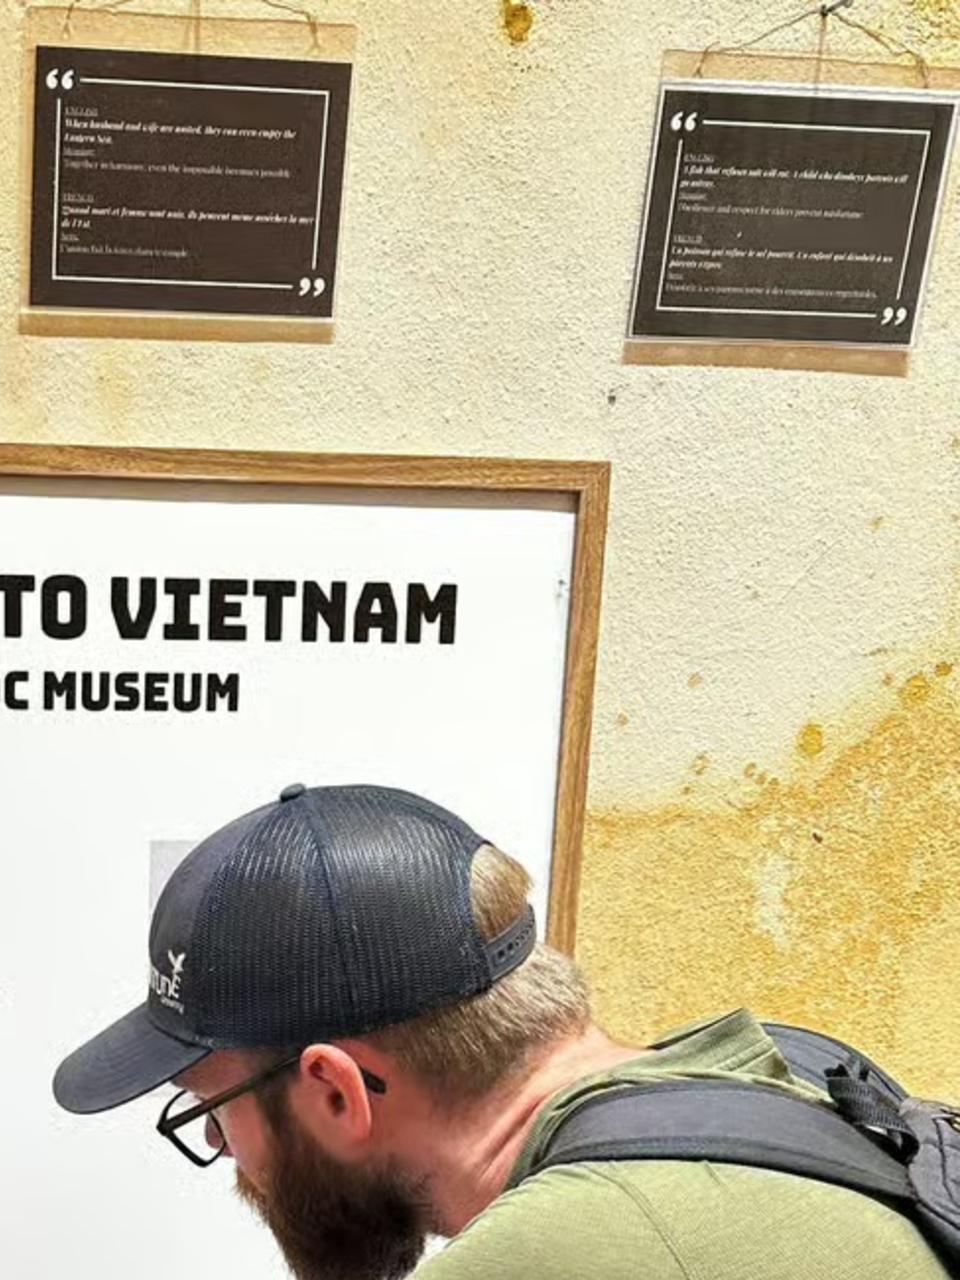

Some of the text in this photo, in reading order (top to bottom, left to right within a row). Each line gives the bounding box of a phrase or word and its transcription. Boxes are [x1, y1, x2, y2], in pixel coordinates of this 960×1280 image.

[65, 119, 88, 129] When
[89, 120, 124, 131] husband
[125, 122, 141, 131] and
[204, 126, 221, 136] they
[258, 130, 282, 140] empty
[283, 129, 296, 138] the
[704, 165, 720, 174] that
[111, 577, 457, 644] VIETNAM
[44, 672, 239, 712] MUSEUM
